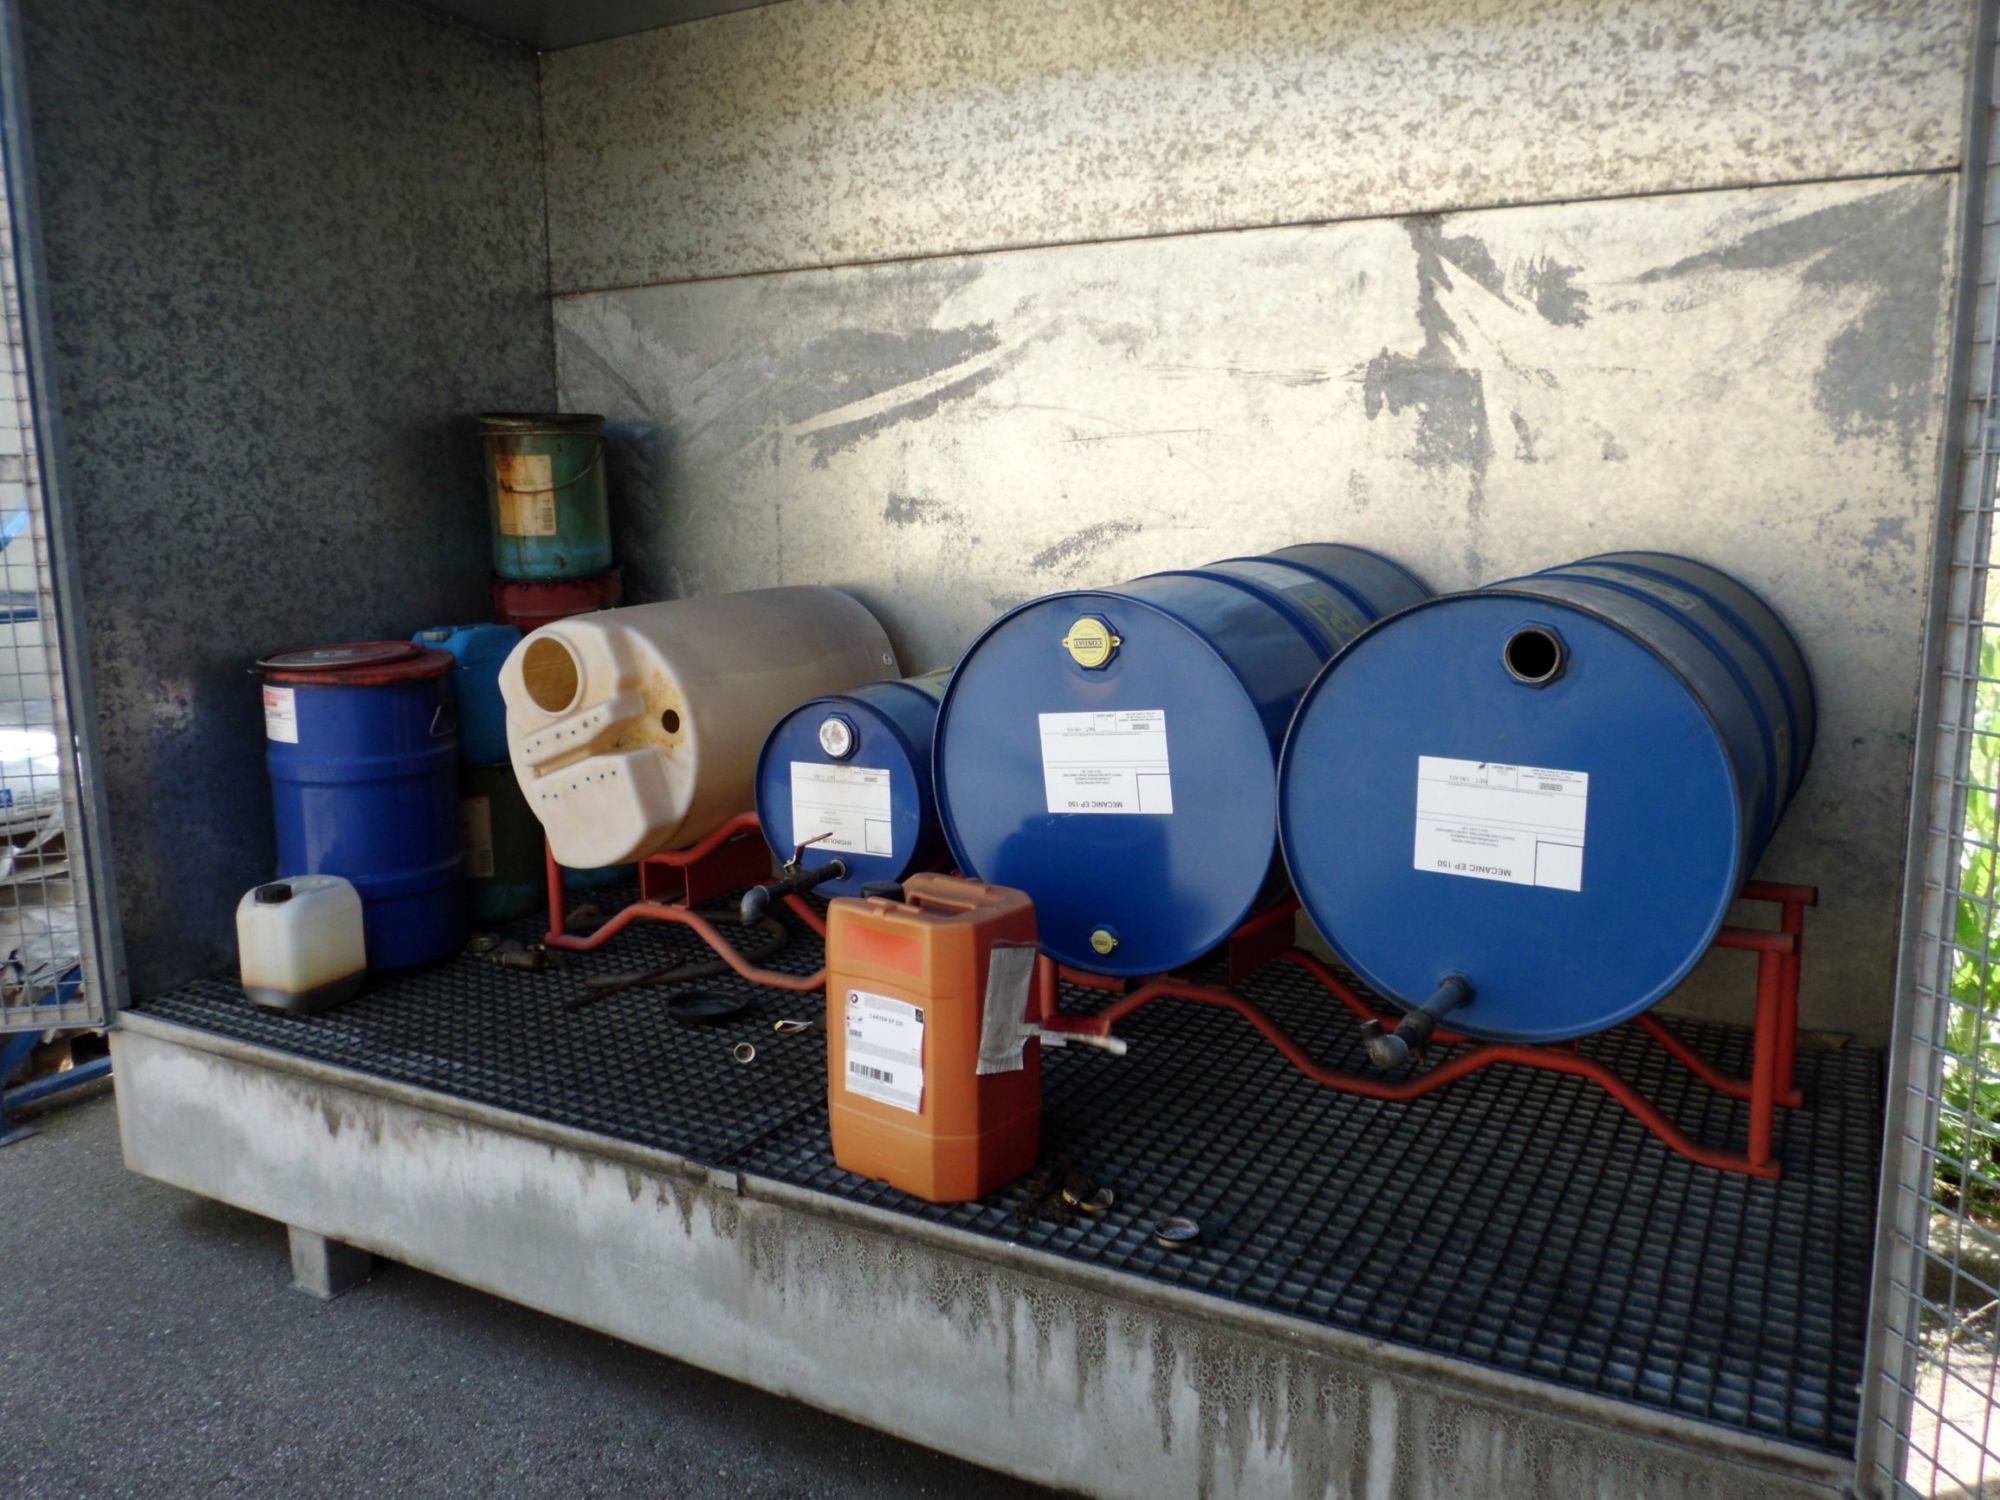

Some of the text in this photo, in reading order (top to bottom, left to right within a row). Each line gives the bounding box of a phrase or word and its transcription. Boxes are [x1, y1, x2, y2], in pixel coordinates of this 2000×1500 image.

[1067, 800, 1123, 808] MECANIC EP 150
[1436, 859, 1512, 877] MECANIC EP 150
